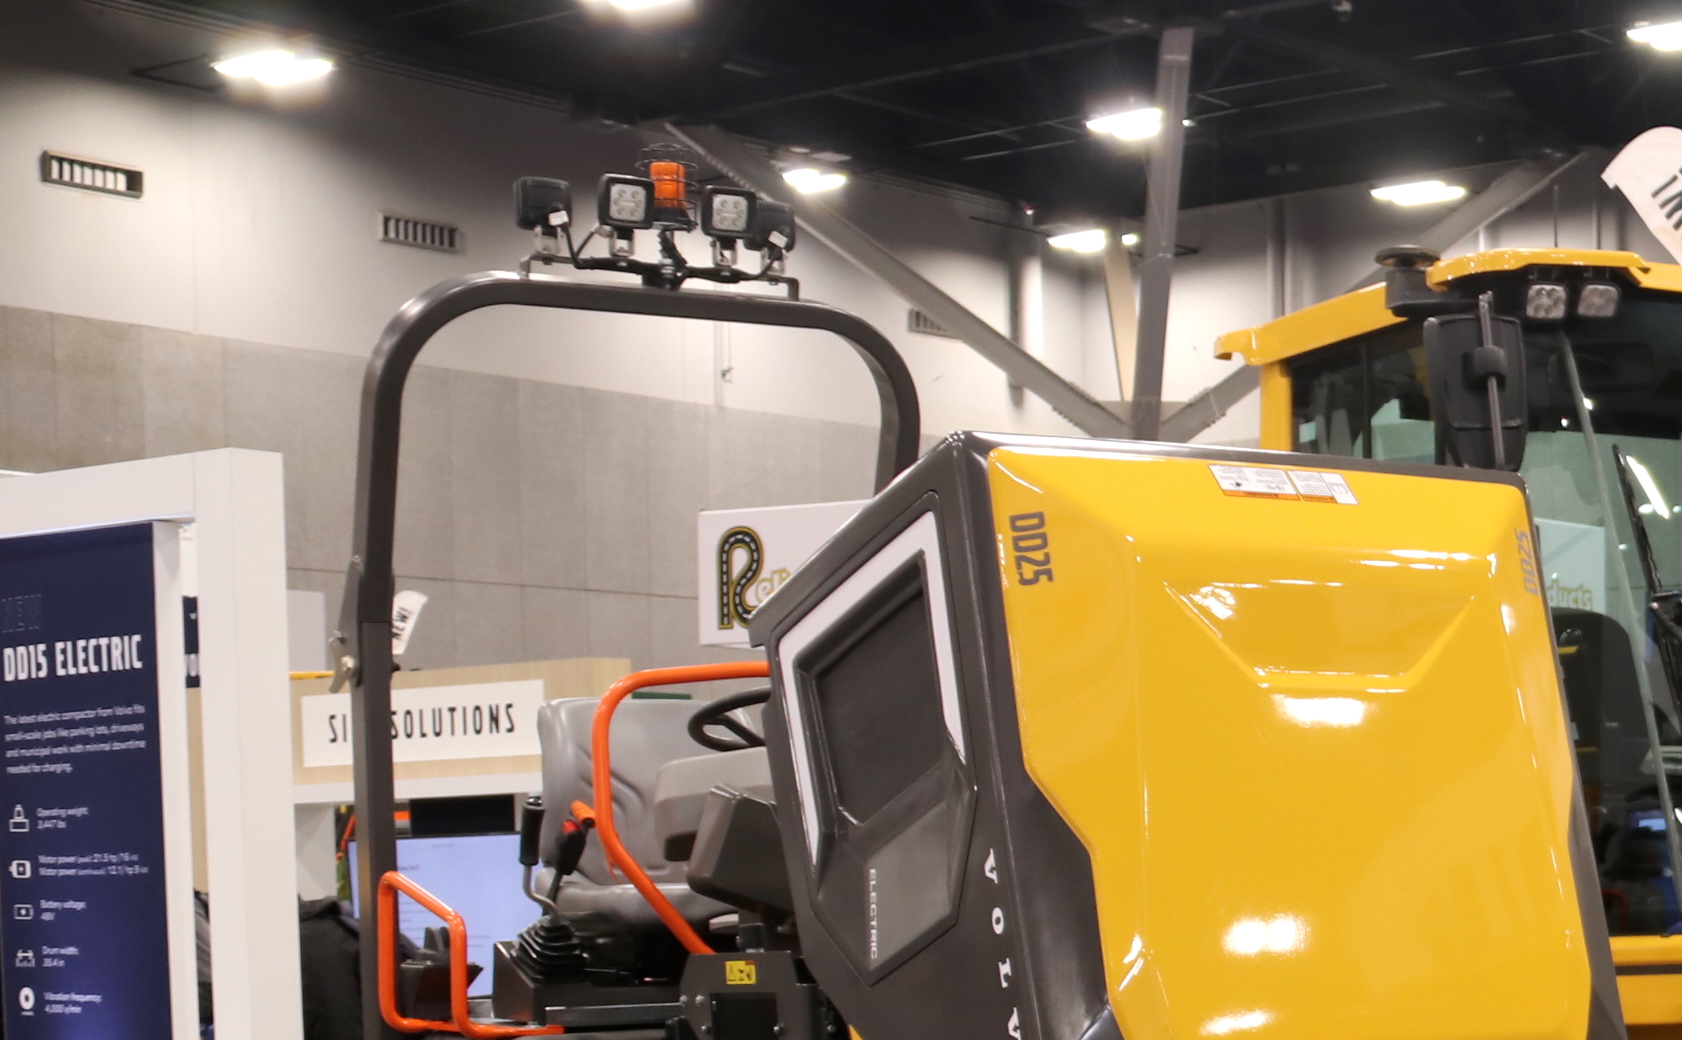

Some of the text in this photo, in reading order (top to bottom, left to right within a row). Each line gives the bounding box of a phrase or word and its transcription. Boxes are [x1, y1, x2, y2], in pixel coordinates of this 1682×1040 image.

[1009, 511, 1055, 586] DD25
[3, 643, 48, 682] DD15
[54, 634, 143, 677] ELECTRIC
[391, 703, 516, 740] SOLUTIONS
[869, 868, 878, 959] ELECTRIC
